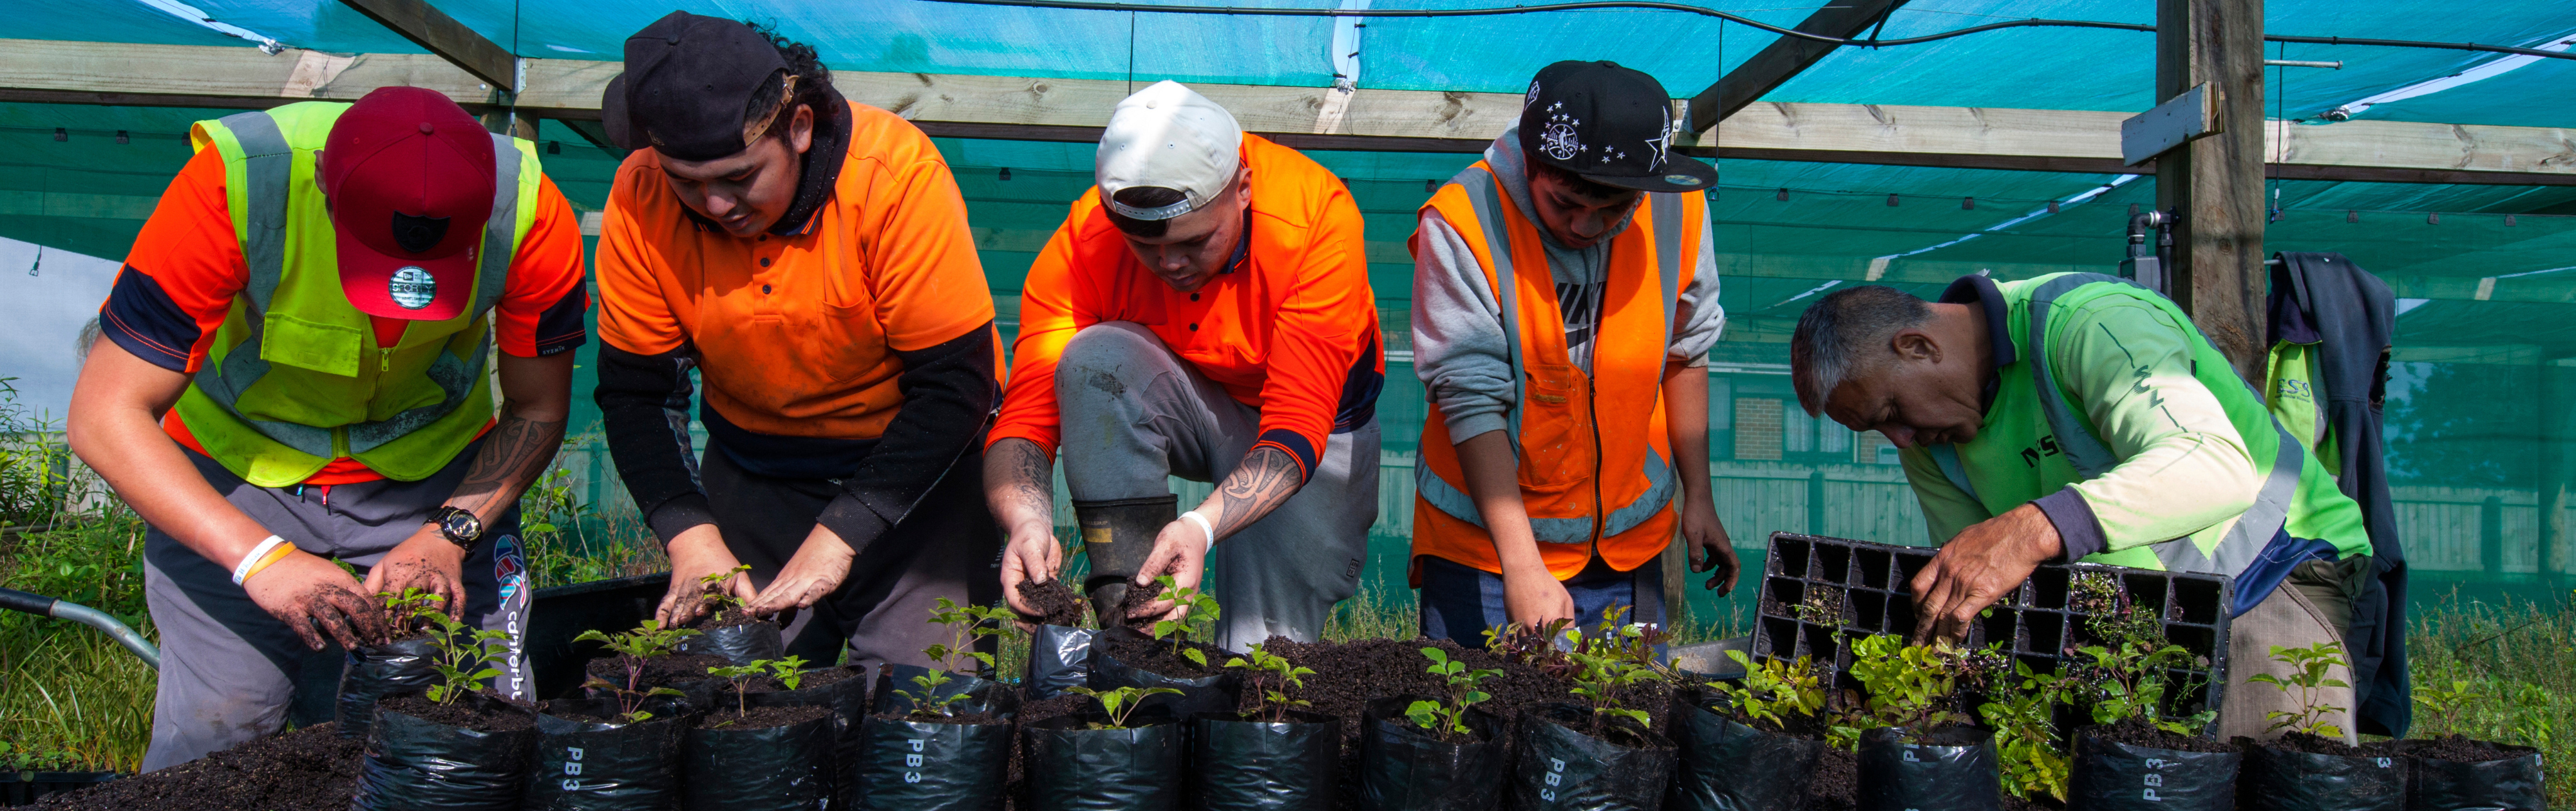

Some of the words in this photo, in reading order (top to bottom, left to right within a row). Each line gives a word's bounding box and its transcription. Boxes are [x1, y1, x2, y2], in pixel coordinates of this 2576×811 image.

[392, 283, 432, 293] 9FORTY
[563, 747, 583, 791] PB3
[905, 739, 924, 783] PB3
[1540, 757, 1565, 801] PB3
[2143, 758, 2163, 801] PB3
